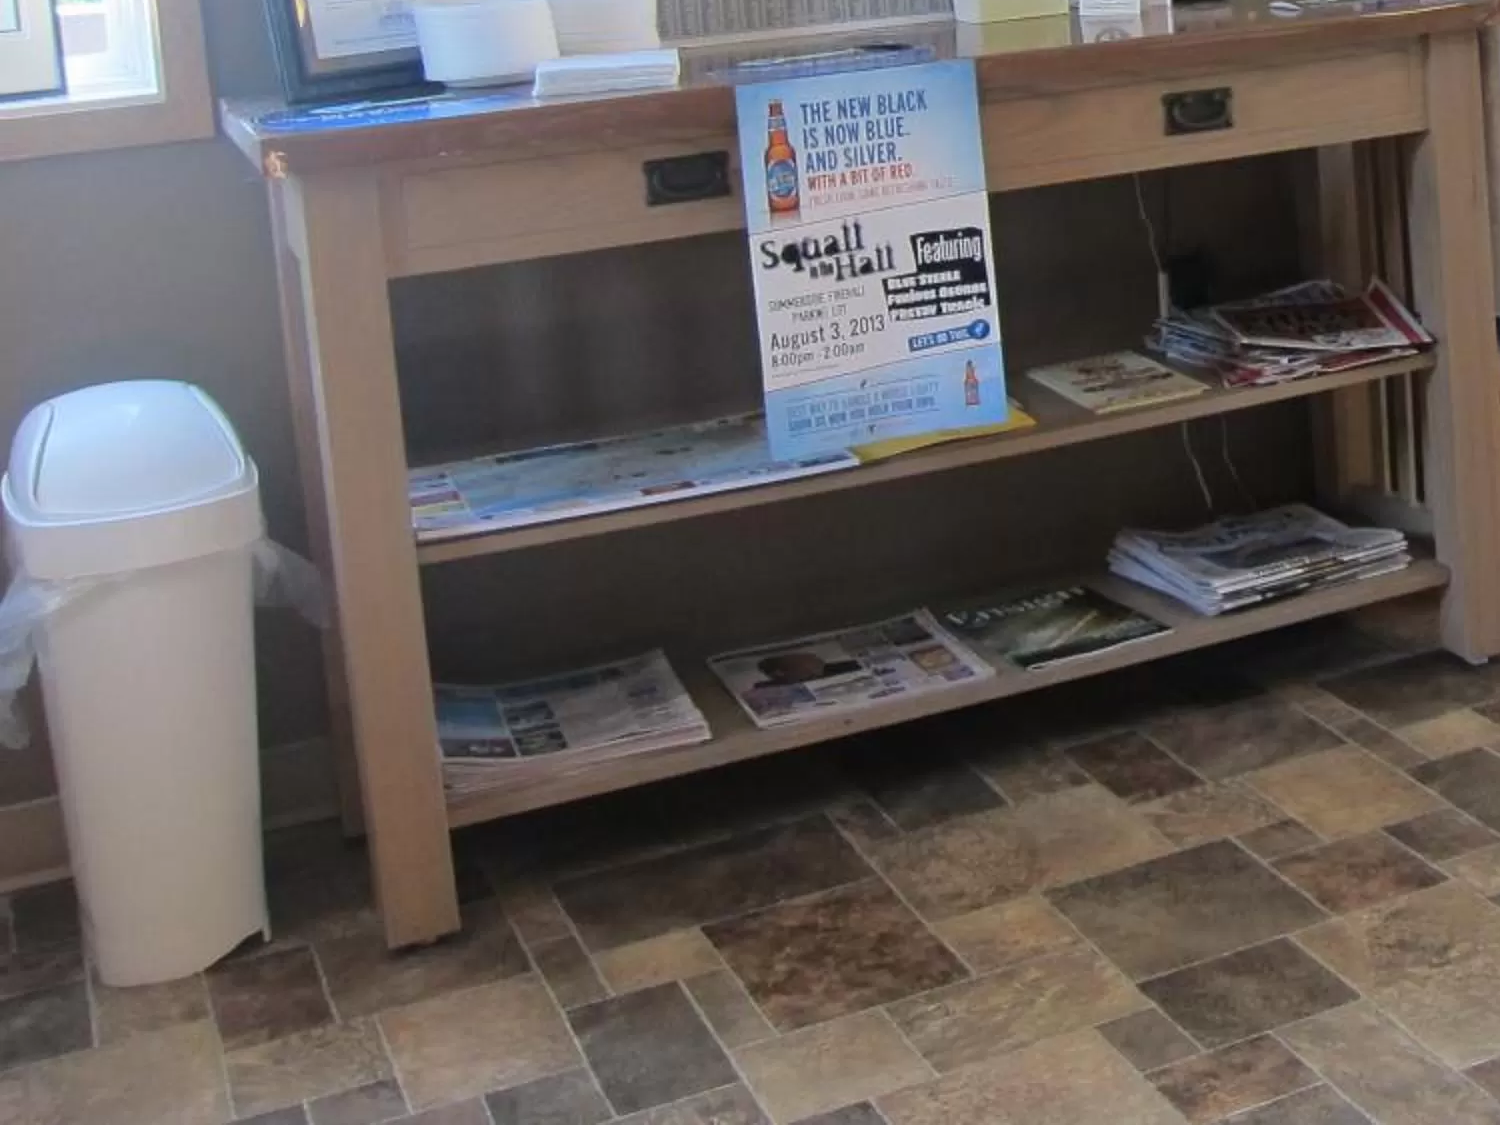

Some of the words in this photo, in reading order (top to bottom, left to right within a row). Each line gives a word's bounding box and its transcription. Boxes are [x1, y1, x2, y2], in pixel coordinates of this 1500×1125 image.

[800, 103, 832, 124] THE
[837, 96, 871, 121] NEW
[876, 89, 928, 116] BLACK
[803, 128, 819, 149] IS
[825, 123, 860, 145] NOW
[805, 150, 838, 174] AND
[843, 141, 903, 169] SILVER.
[807, 173, 837, 192] WITH
[839, 172, 848, 187] A
[850, 167, 869, 186] BIT
[872, 166, 886, 182] OF
[888, 162, 914, 180] RED
[760, 219, 864, 272] Squall
[835, 241, 896, 281] Hall
[916, 231, 983, 266] Featuring
[771, 325, 825, 352] August
[830, 322, 846, 341] 3,
[849, 315, 885, 337] 2013
